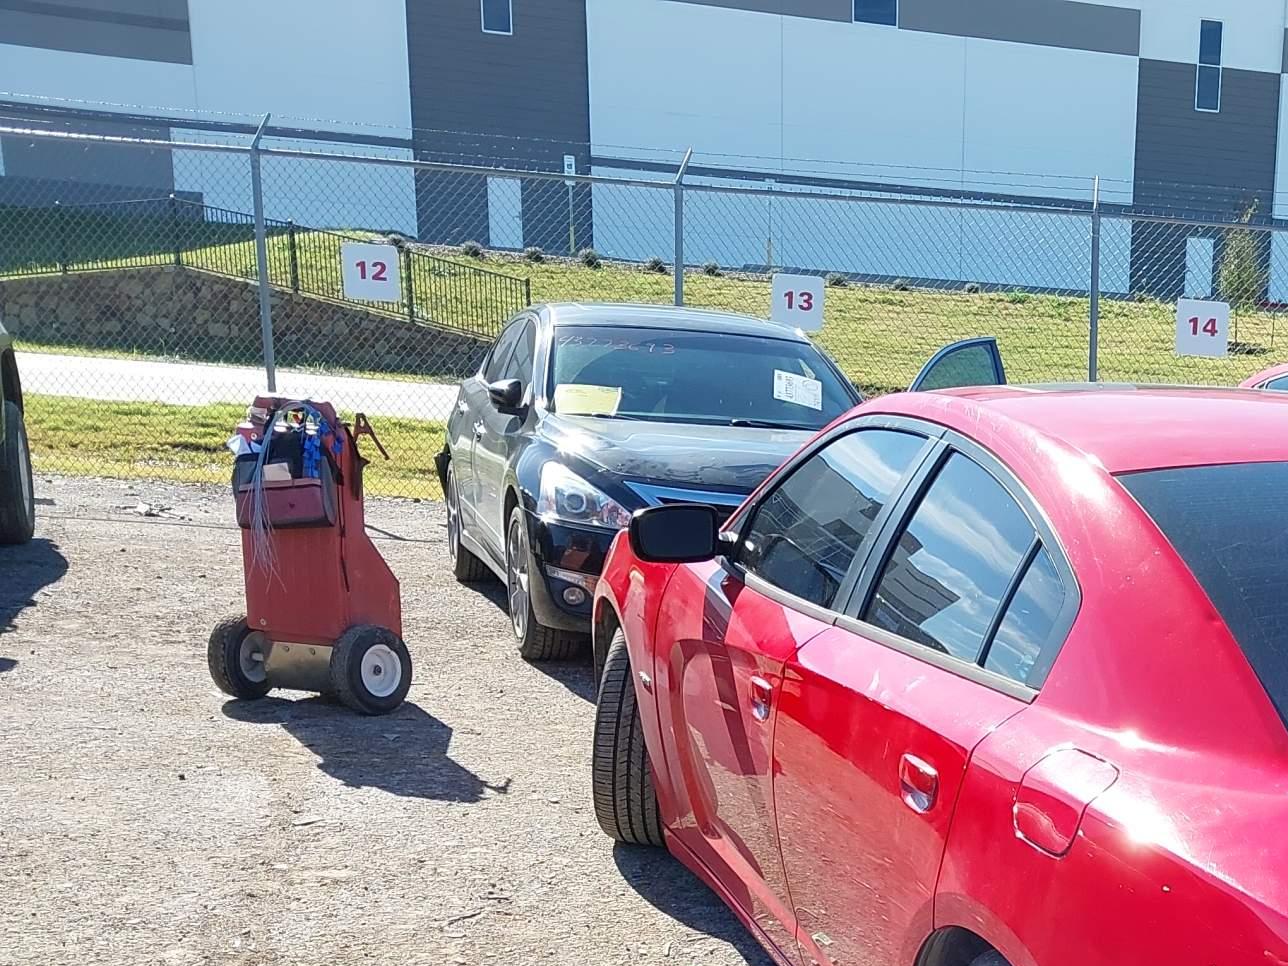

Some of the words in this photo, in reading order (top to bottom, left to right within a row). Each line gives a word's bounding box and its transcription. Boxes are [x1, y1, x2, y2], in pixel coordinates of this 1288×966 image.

[355, 260, 388, 282] 12
[783, 290, 814, 312] 13
[1188, 316, 1219, 337] 14
